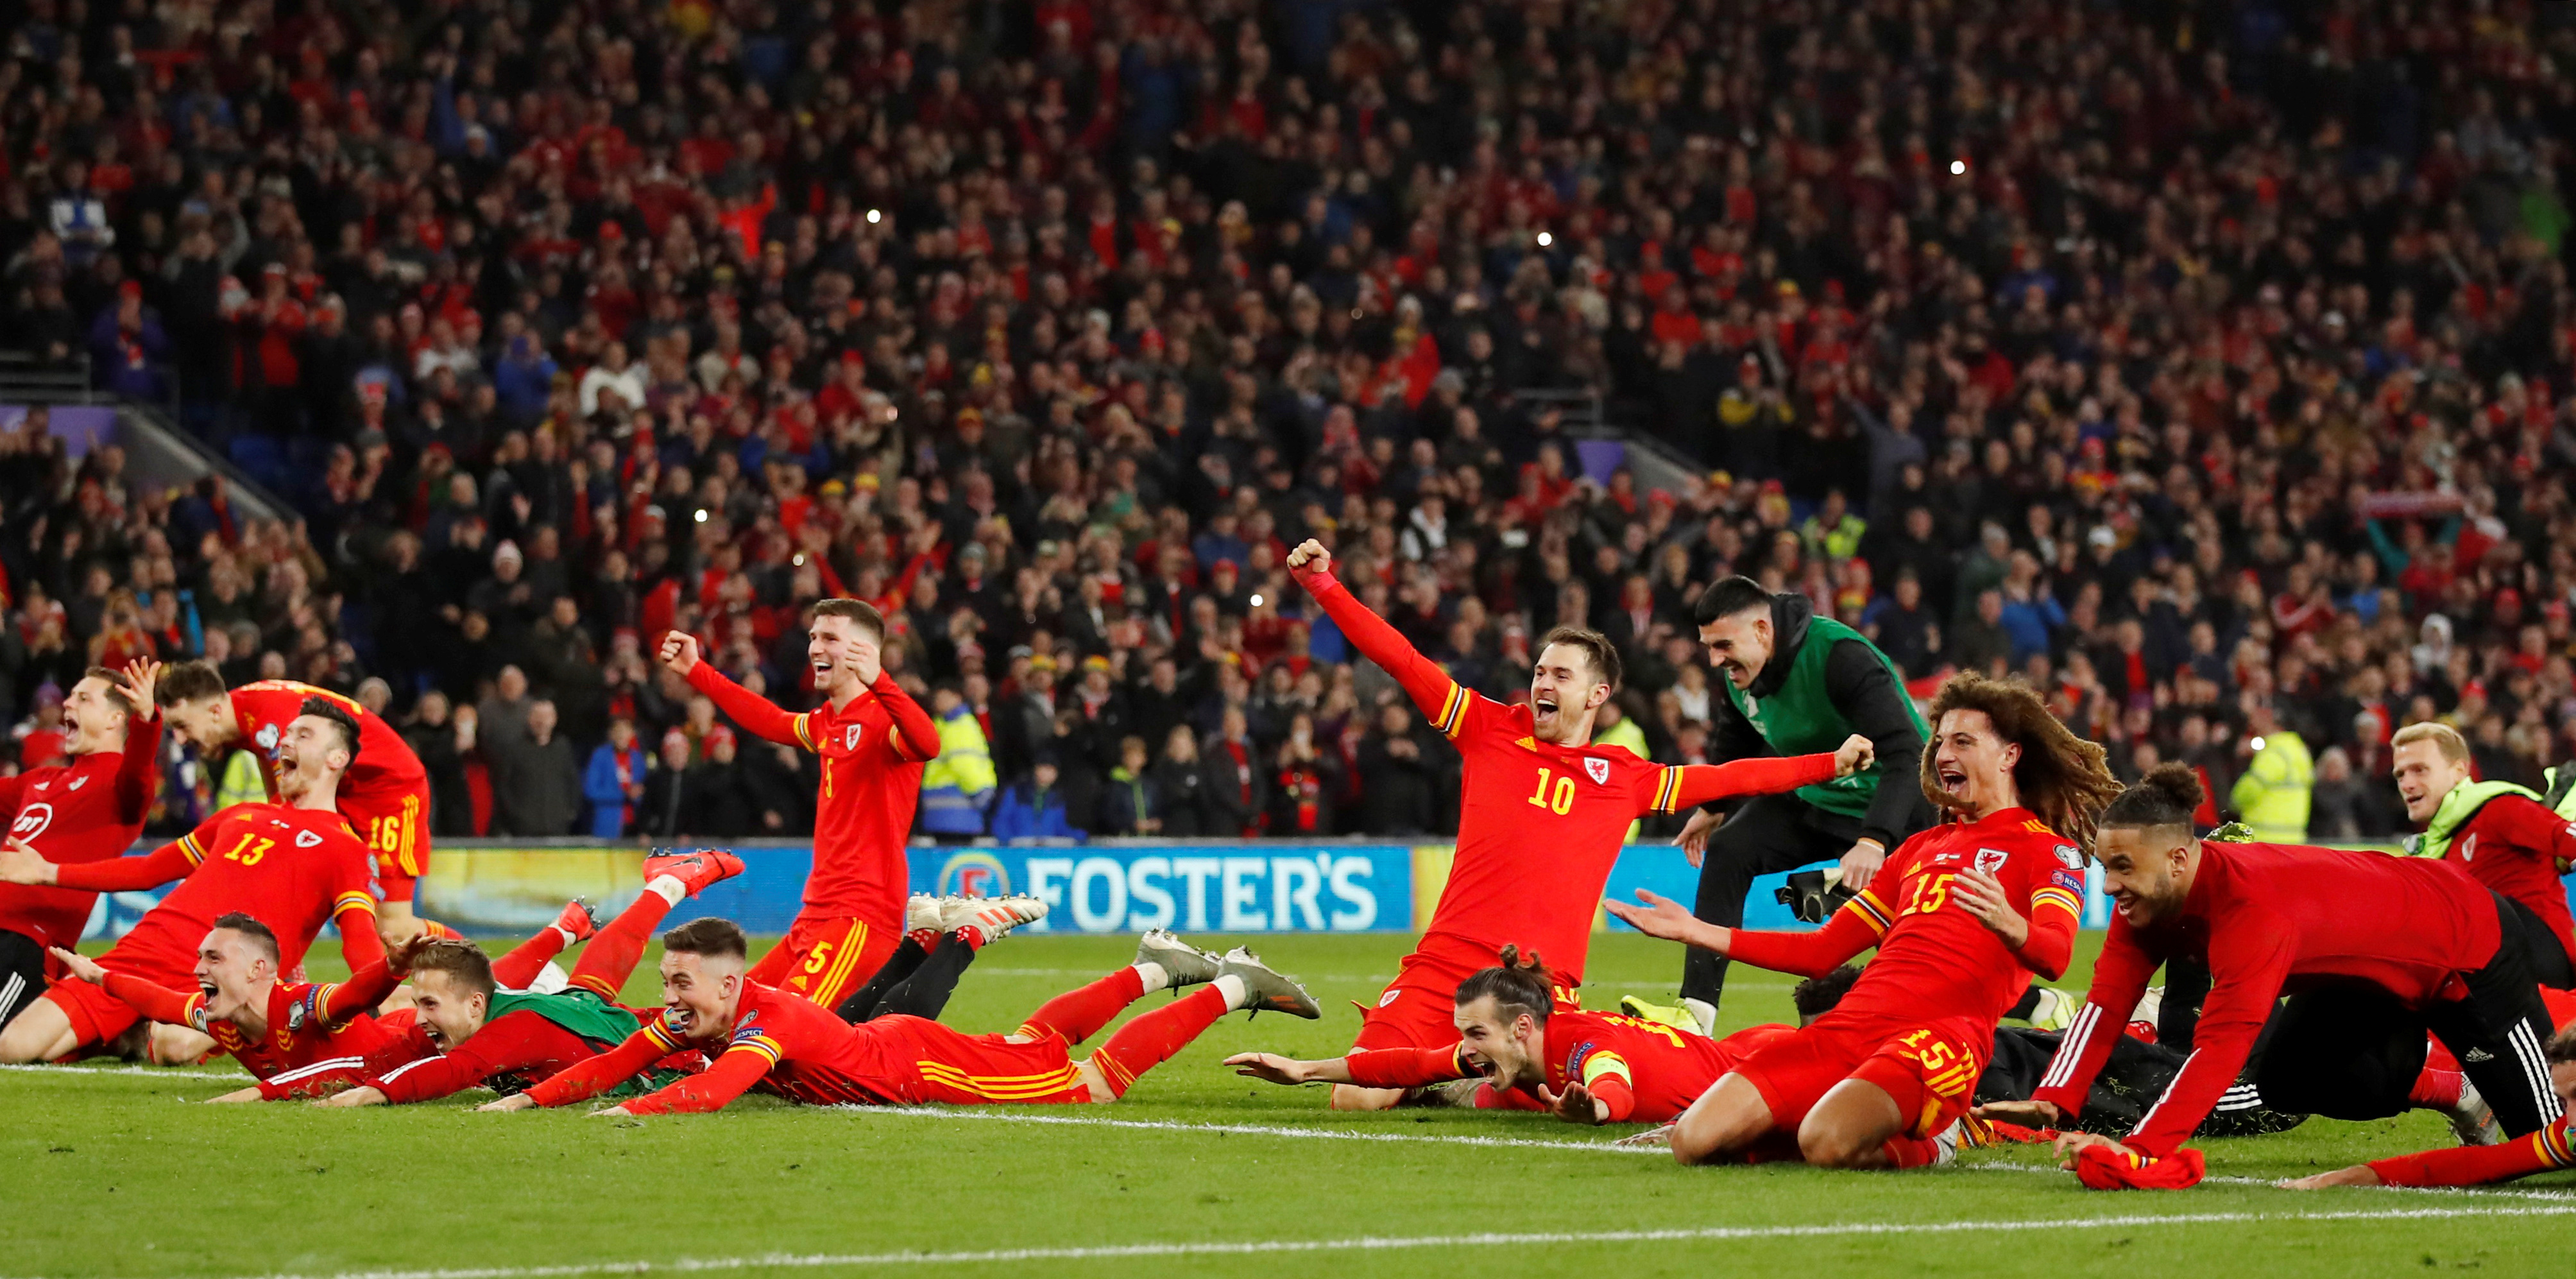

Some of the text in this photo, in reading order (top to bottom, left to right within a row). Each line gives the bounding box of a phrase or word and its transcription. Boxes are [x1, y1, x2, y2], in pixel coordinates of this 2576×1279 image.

[826, 758, 833, 798] 5
[1528, 768, 1575, 816] 10
[13, 816, 44, 832] BT
[368, 816, 400, 852] 16
[224, 833, 275, 866] 13
[1028, 852, 1378, 932] FOSTER'S
[1901, 873, 1954, 916] 15
[804, 940, 833, 974] 5
[1573, 1042, 1592, 1069] RESPECT
[1898, 1029, 1956, 1070] 15
